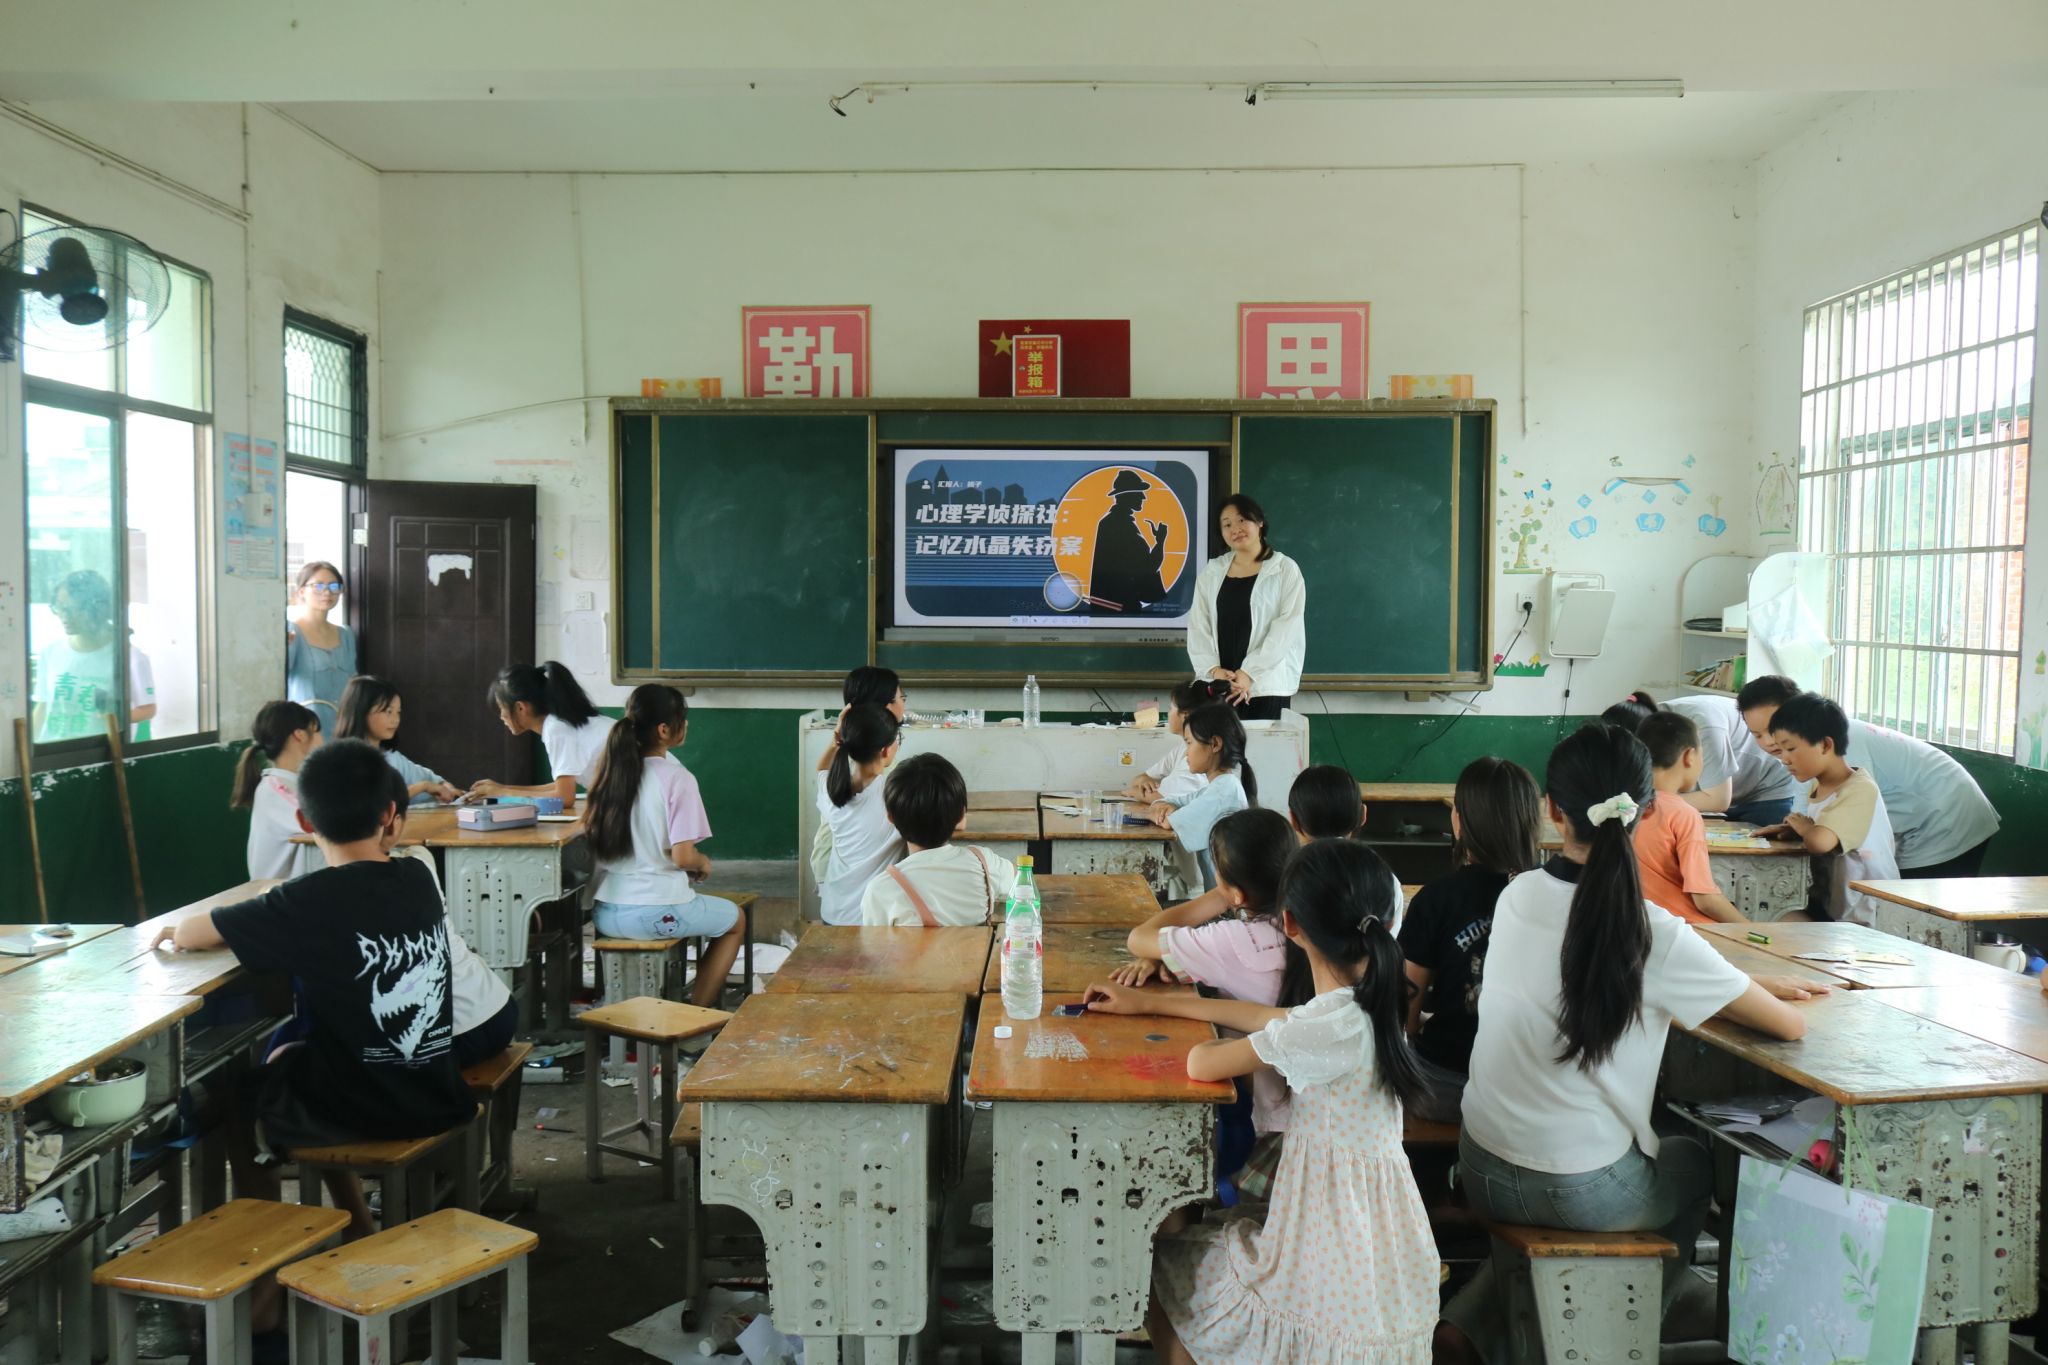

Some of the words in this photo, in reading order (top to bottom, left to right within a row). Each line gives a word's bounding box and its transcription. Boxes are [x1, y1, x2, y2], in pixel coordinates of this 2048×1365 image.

[1027, 351, 1043, 388] 举报箱
[915, 503, 1070, 525] 心理学侦探社：
[915, 535, 1084, 556] 记忆水晶失窃案
